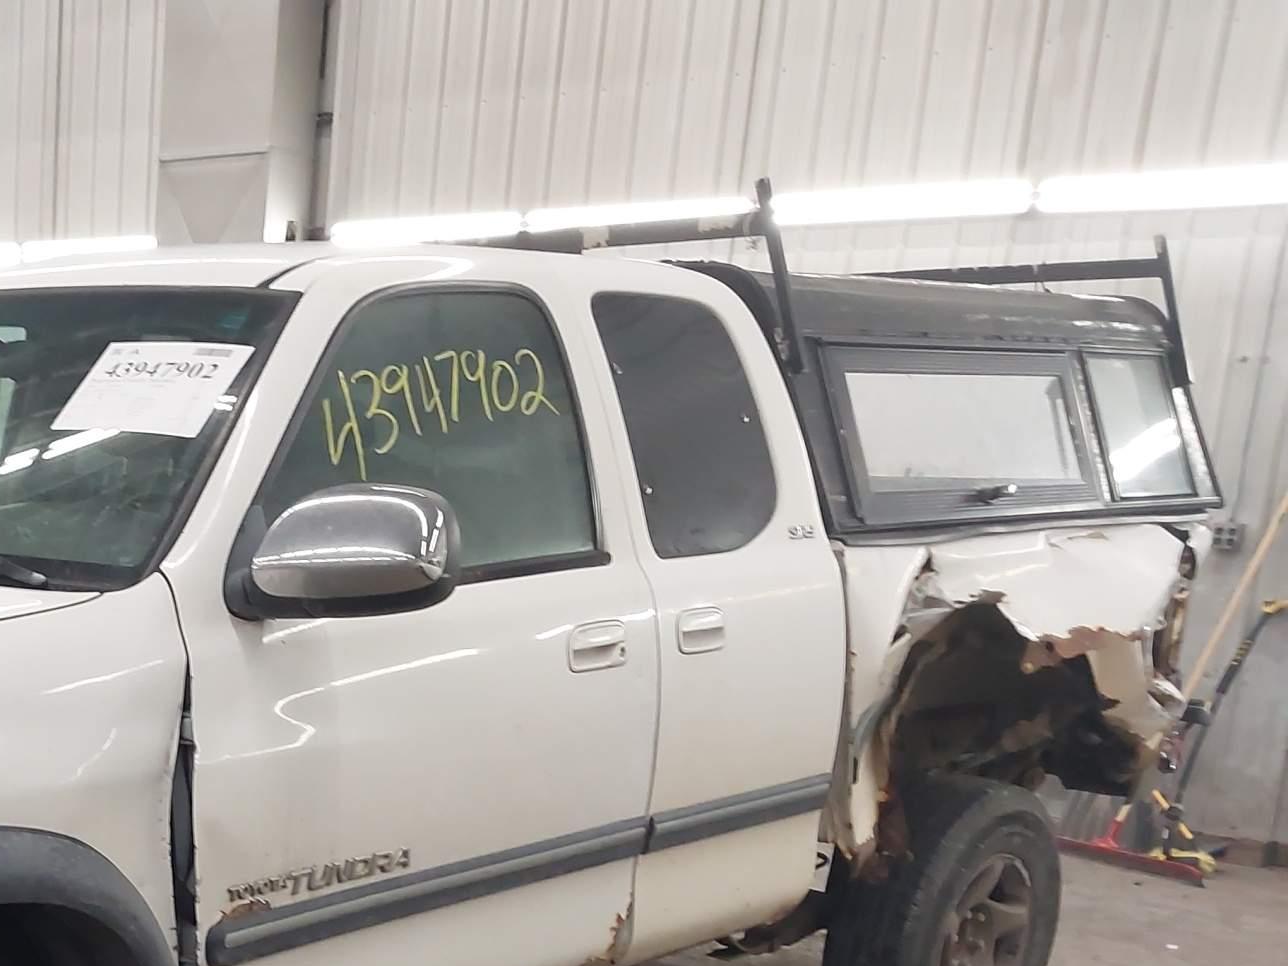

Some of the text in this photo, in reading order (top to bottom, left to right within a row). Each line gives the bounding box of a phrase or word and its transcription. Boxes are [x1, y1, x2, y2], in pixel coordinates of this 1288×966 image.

[104, 361, 220, 379] 43947902
[323, 349, 560, 481] 43947902
[289, 847, 411, 896] TUNDRA
